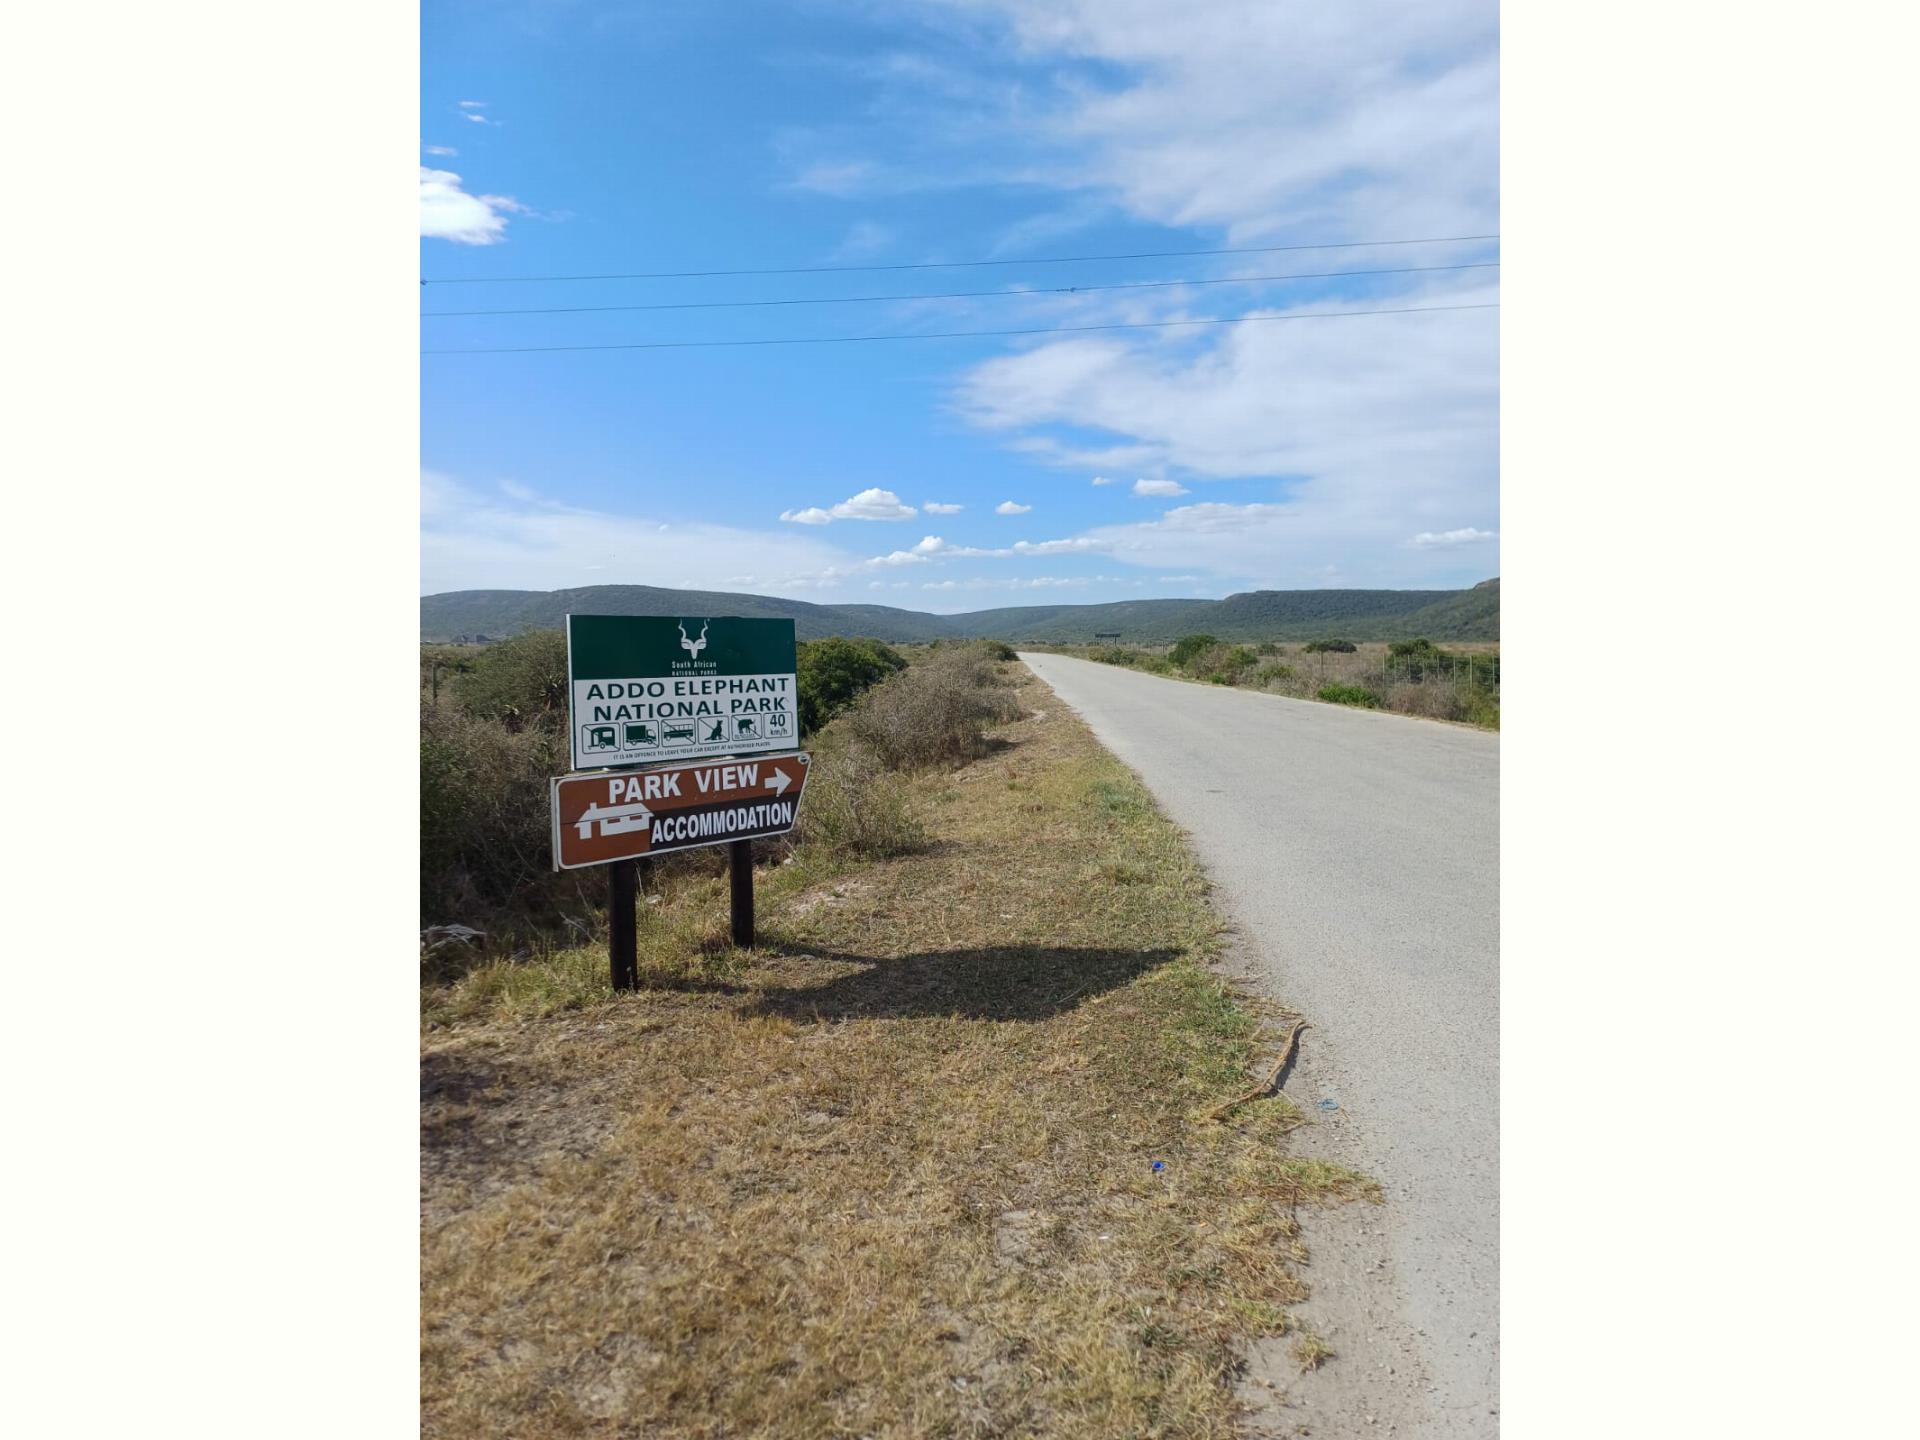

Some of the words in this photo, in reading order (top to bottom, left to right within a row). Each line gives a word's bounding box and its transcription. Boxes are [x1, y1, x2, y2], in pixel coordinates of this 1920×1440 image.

[671, 660, 691, 669] South
[693, 660, 717, 669] African
[586, 682, 665, 701] ADDO
[674, 677, 789, 697] ELEPHANT
[594, 700, 724, 722] NATIONAL
[731, 697, 786, 714] PARK
[770, 714, 786, 728] 40
[770, 728, 788, 736] km/h
[608, 773, 681, 804] PARK
[695, 764, 759, 793] VIEW
[651, 801, 792, 844] ACCOMMODATION
